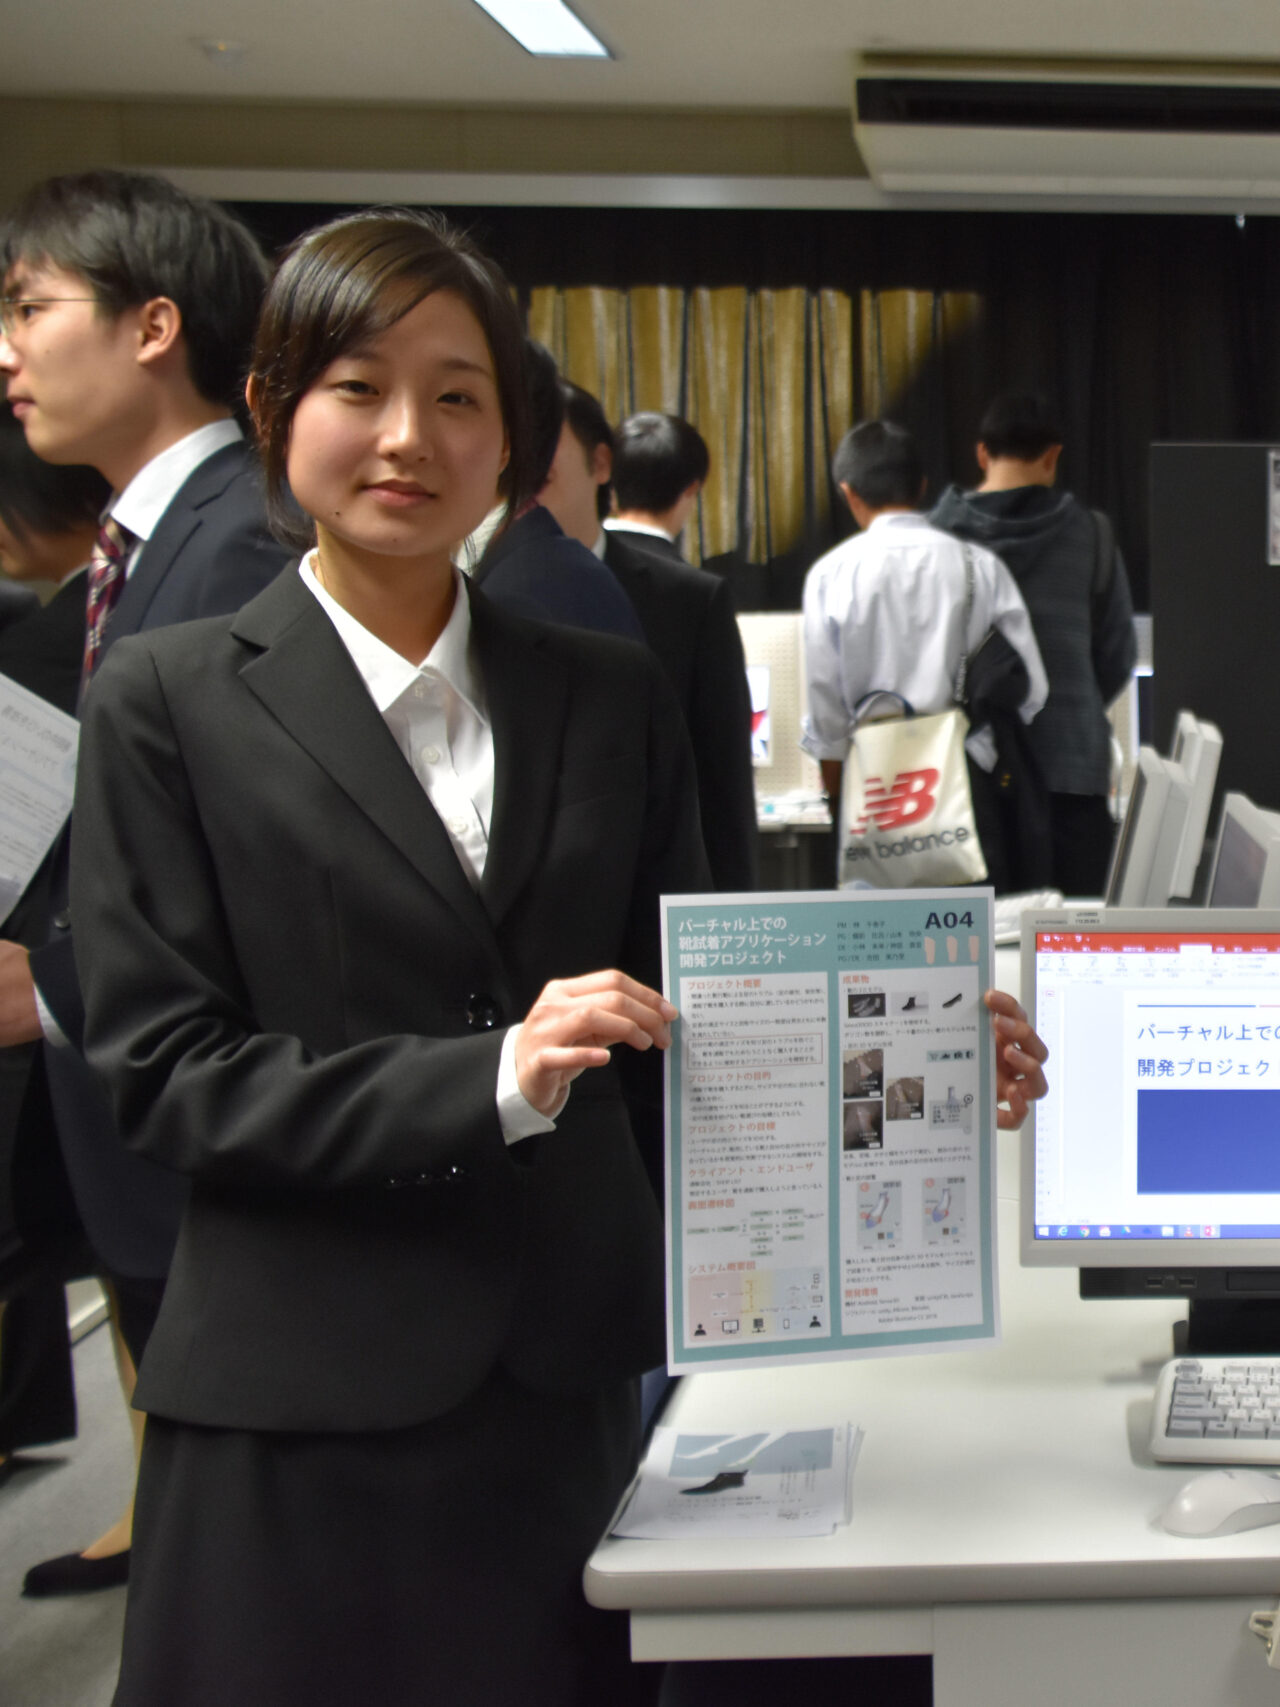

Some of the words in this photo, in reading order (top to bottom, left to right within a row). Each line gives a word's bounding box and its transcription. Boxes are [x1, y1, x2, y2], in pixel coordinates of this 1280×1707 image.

[845, 846, 872, 860] ew
[874, 826, 969, 859] balance
[677, 916, 788, 933] バーチャル上での
[924, 911, 974, 930] A04
[678, 932, 827, 952] 靴試着アプリケーション
[679, 950, 788, 969] 開発プロジェクト
